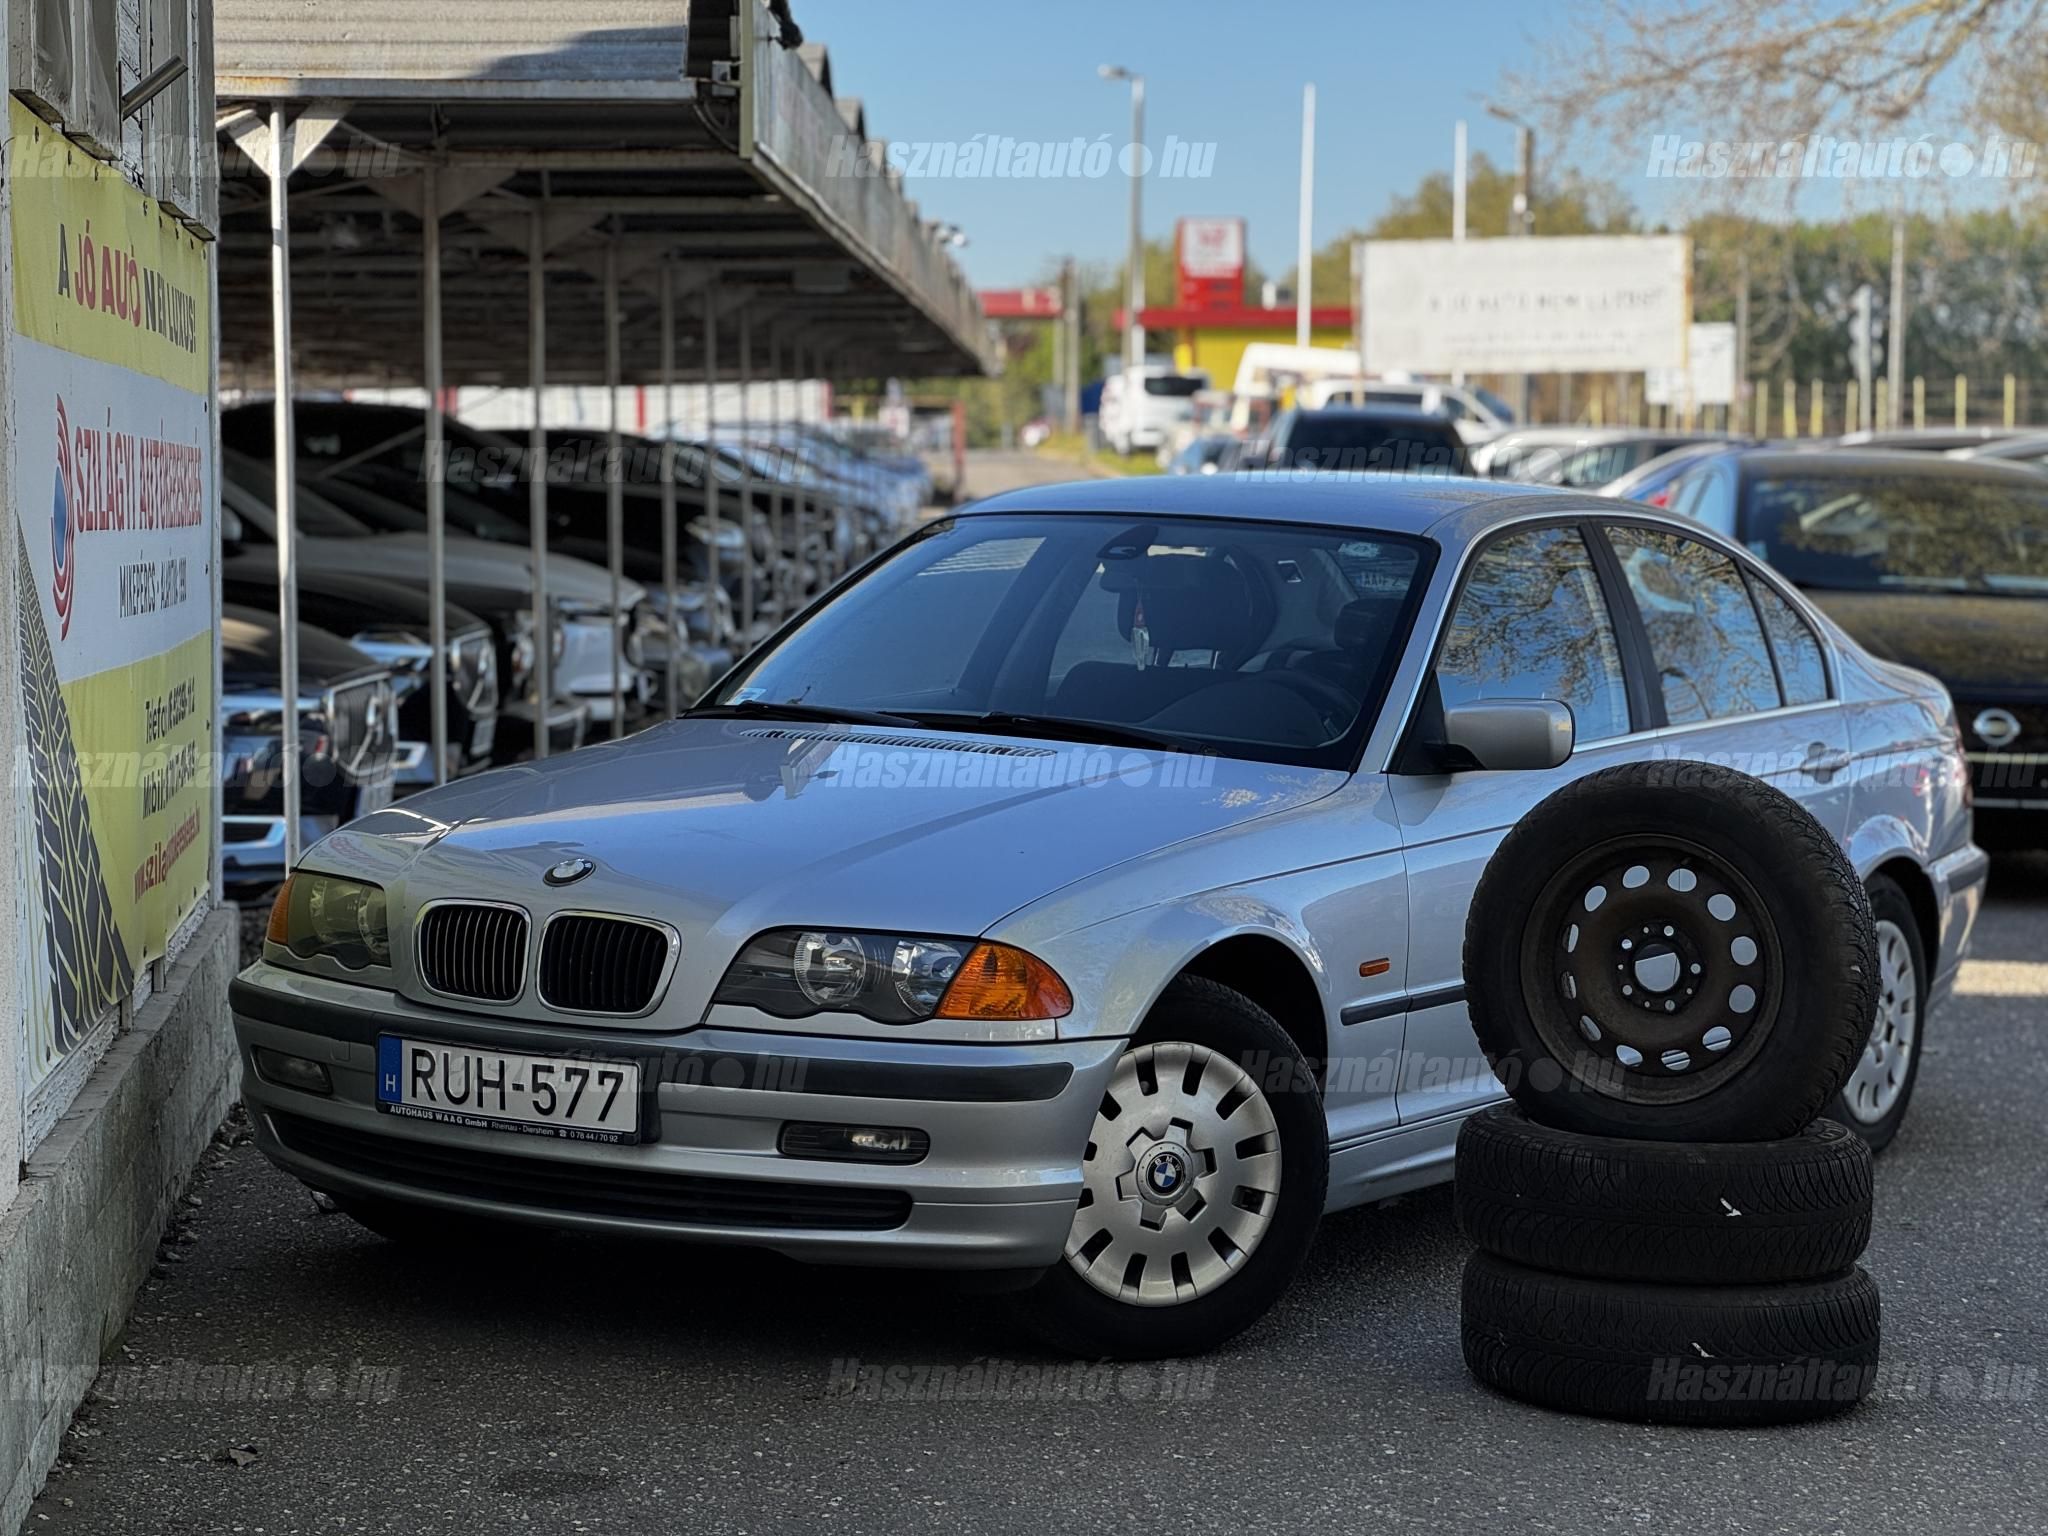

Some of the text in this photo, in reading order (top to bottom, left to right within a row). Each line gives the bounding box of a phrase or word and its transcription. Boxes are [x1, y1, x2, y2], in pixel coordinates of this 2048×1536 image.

[58, 223, 70, 299] A
[75, 219, 96, 310] JÓ
[102, 245, 141, 328] AUÓ
[76, 407, 135, 533] SZILÁGYI
[386, 1073, 396, 1092] H
[390, 1105, 433, 1120] AUTOHAUS
[411, 1048, 624, 1122] RUH-577
